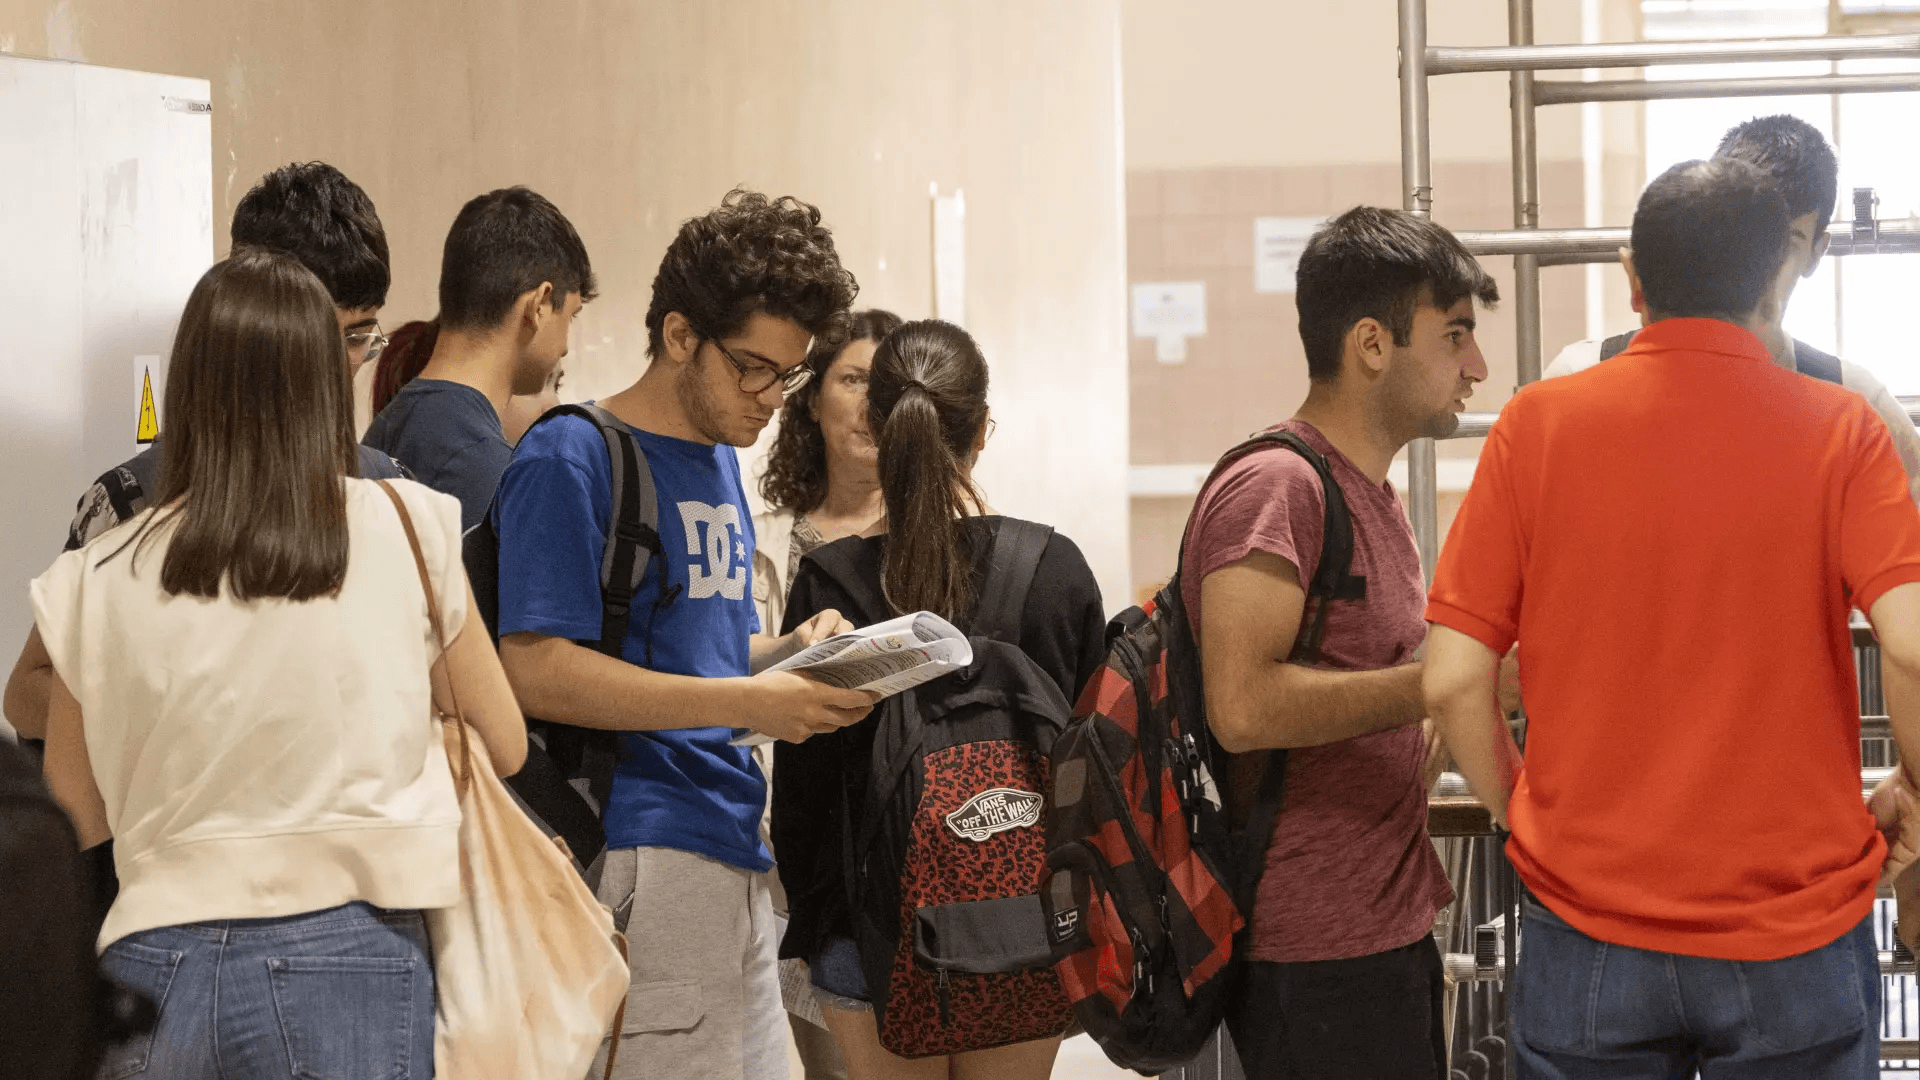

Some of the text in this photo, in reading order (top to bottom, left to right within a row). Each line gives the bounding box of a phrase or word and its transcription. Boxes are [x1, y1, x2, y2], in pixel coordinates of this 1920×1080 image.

[676, 501, 746, 600] DC
[973, 793, 1007, 816] VANS
[982, 806, 1008, 826] THE
